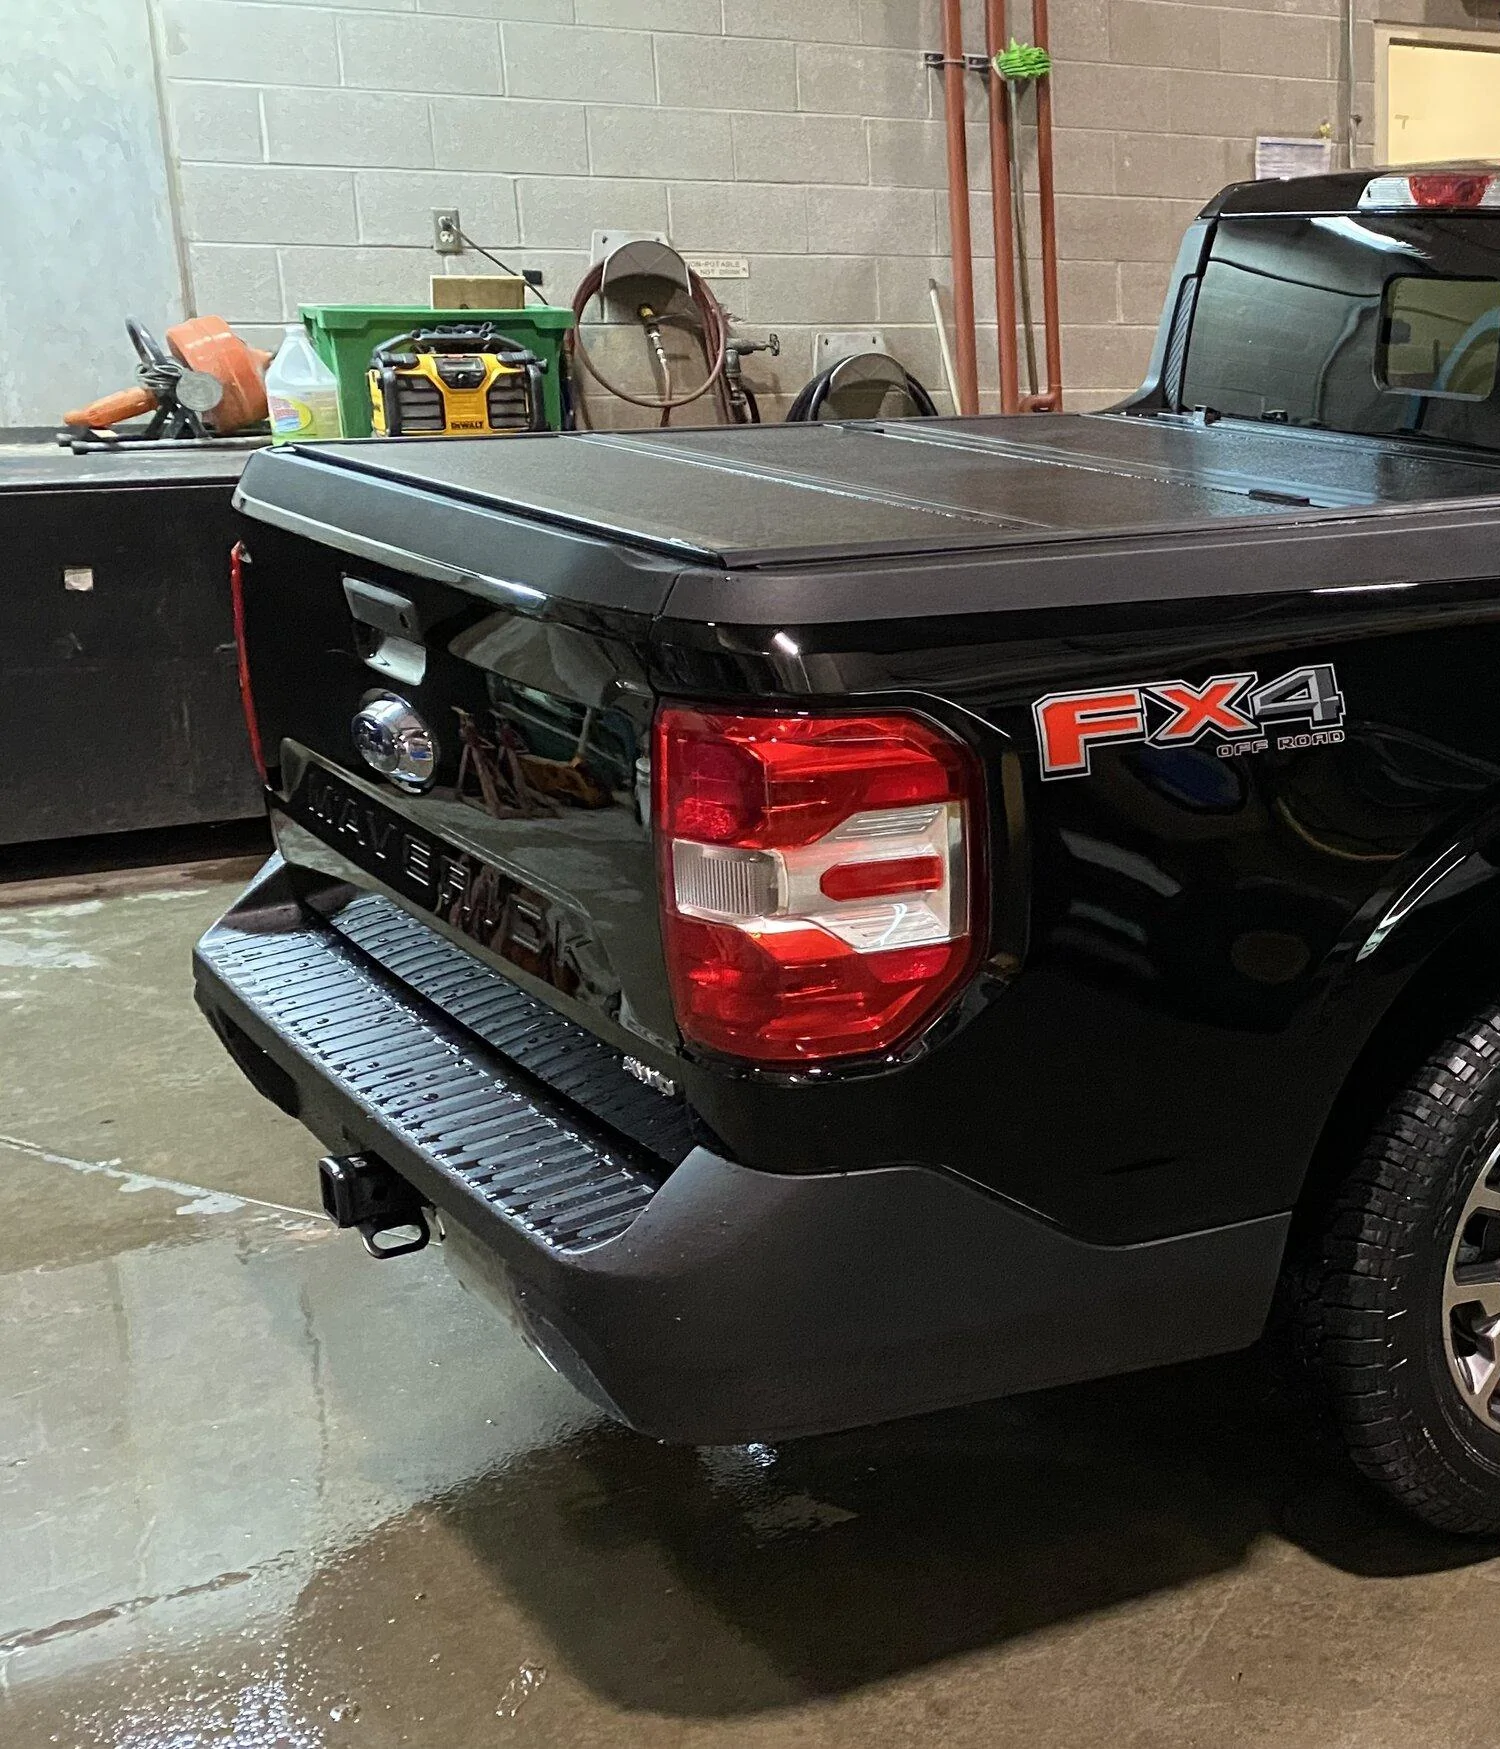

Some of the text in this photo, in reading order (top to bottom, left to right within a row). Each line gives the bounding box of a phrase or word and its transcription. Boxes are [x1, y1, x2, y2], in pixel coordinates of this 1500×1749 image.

[1031, 663, 1345, 781] FX4
[1216, 729, 1345, 758] OFF ROAD
